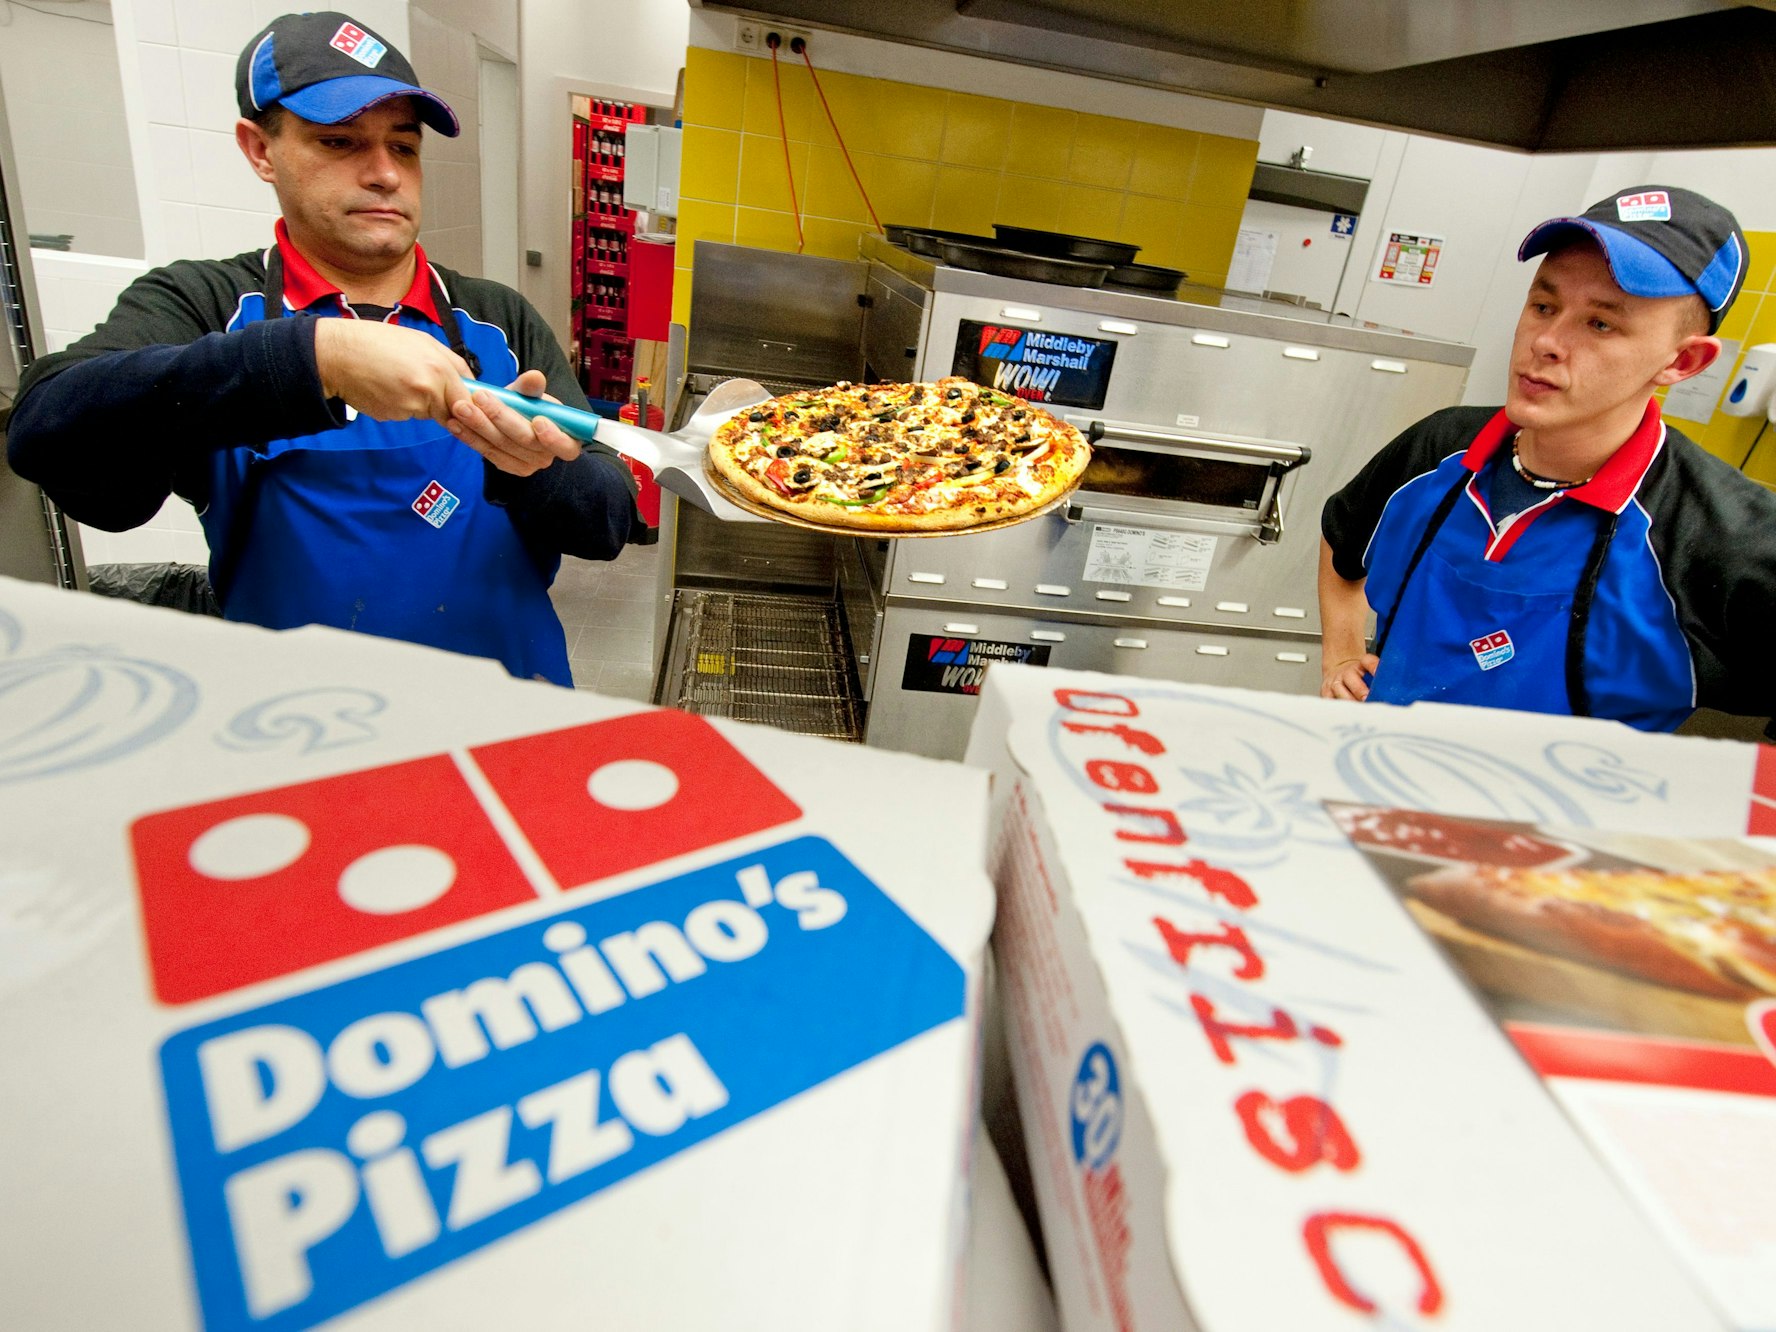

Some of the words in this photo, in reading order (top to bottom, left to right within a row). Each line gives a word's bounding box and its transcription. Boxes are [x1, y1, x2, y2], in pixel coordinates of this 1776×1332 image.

[1026, 332, 1096, 358] Middleby
[1022, 349, 1089, 370] Marshall
[993, 362, 1062, 401] WOW!
[1016, 387, 1044, 401] OVEN
[427, 495, 451, 521] Domino's
[969, 641, 1031, 659] Middleby
[197, 864, 848, 1153] Domino's
[1073, 1052, 1123, 1165] 30
[224, 1032, 729, 1321] Pizza
